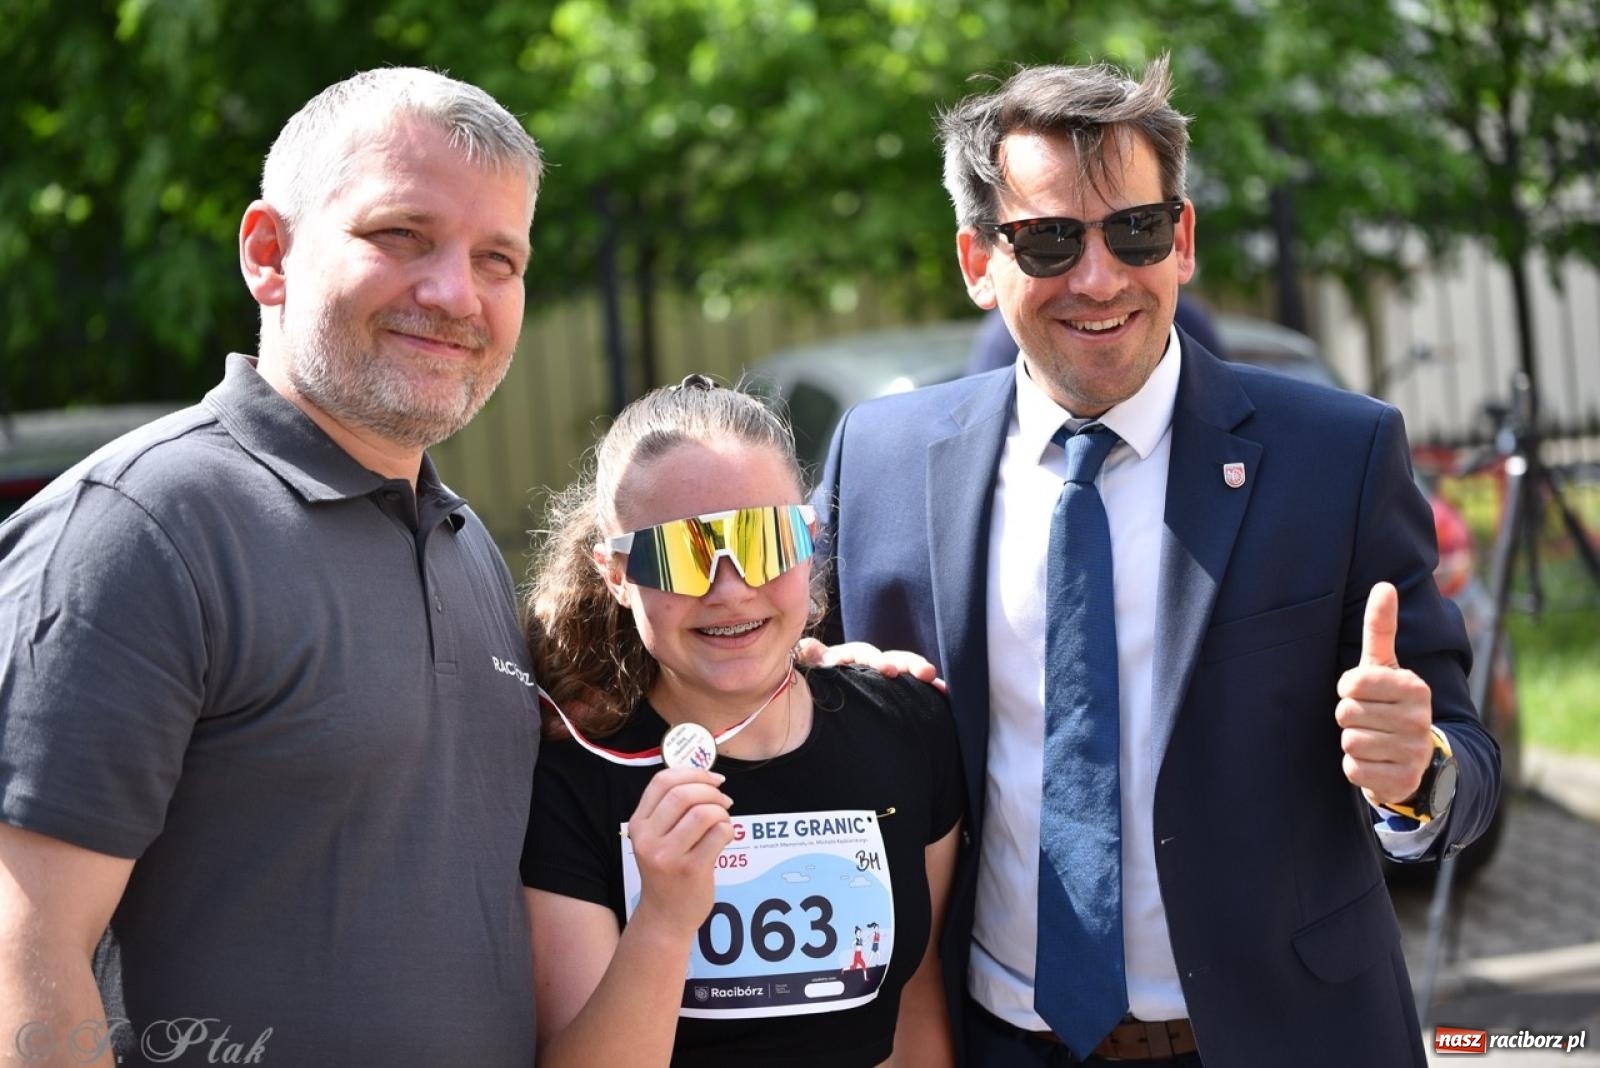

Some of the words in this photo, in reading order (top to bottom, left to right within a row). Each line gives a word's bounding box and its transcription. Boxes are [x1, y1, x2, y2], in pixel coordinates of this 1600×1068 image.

[752, 820, 789, 840] BEZ
[794, 816, 866, 837] GRANIC
[713, 853, 748, 869] 025
[697, 894, 838, 966] 063
[710, 985, 764, 998] Racibórz
